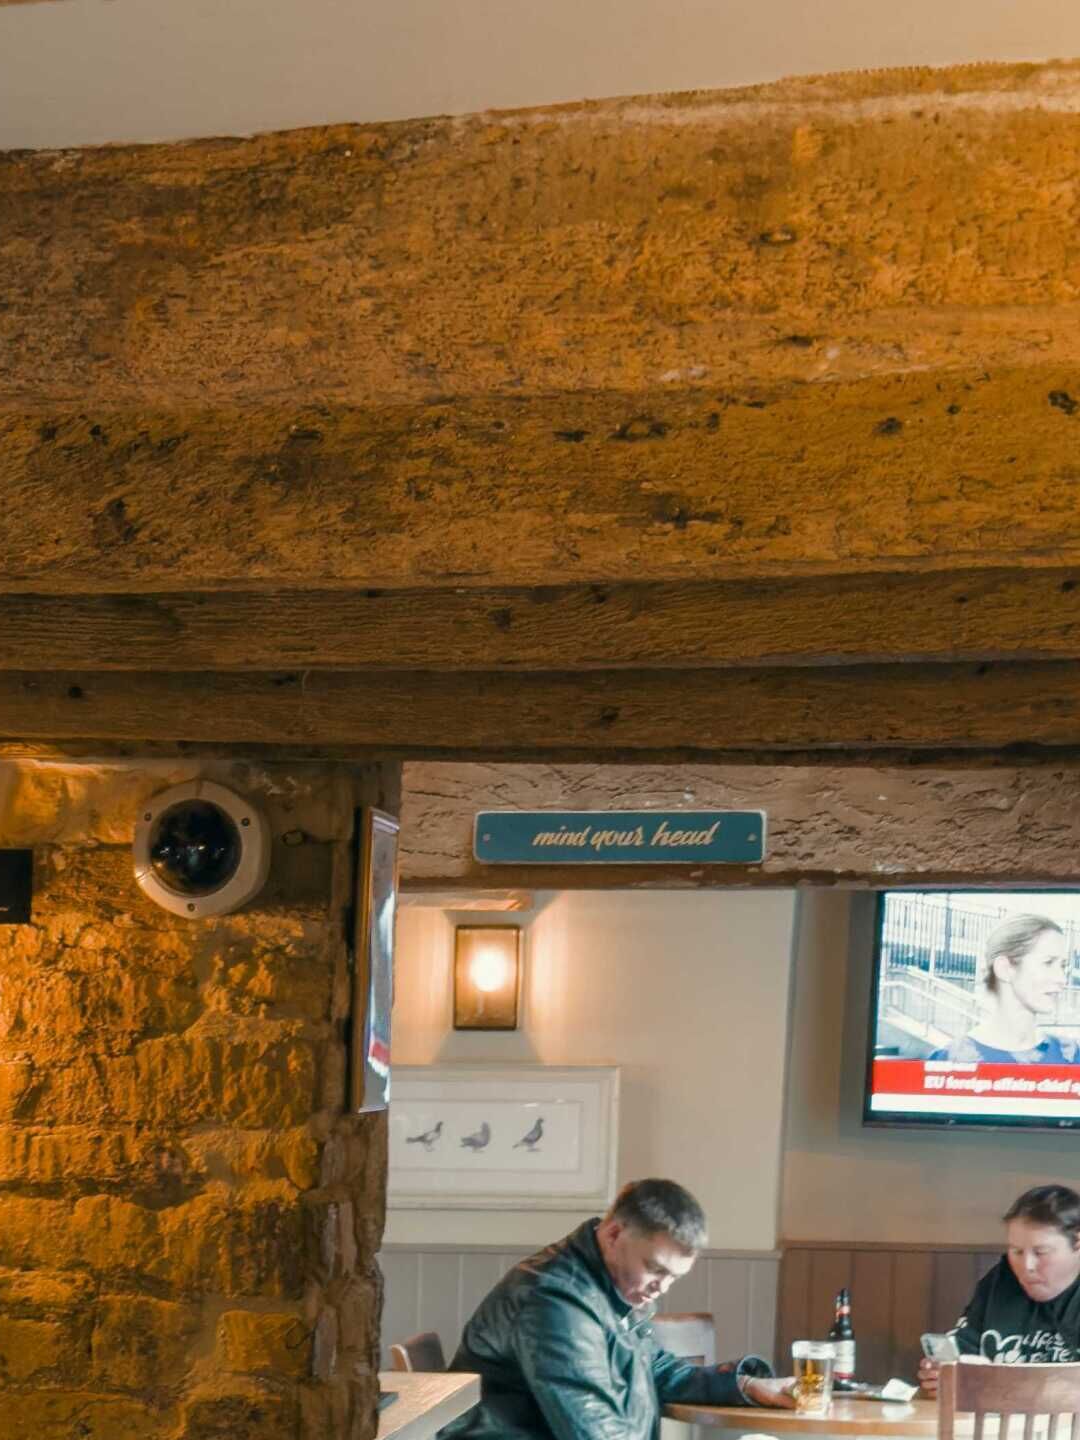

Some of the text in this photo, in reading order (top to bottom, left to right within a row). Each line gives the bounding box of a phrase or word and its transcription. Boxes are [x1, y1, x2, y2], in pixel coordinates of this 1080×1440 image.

[532, 821, 721, 851] mind your head
[924, 1075, 945, 1090] EU
[946, 1076, 993, 1093] foreign
